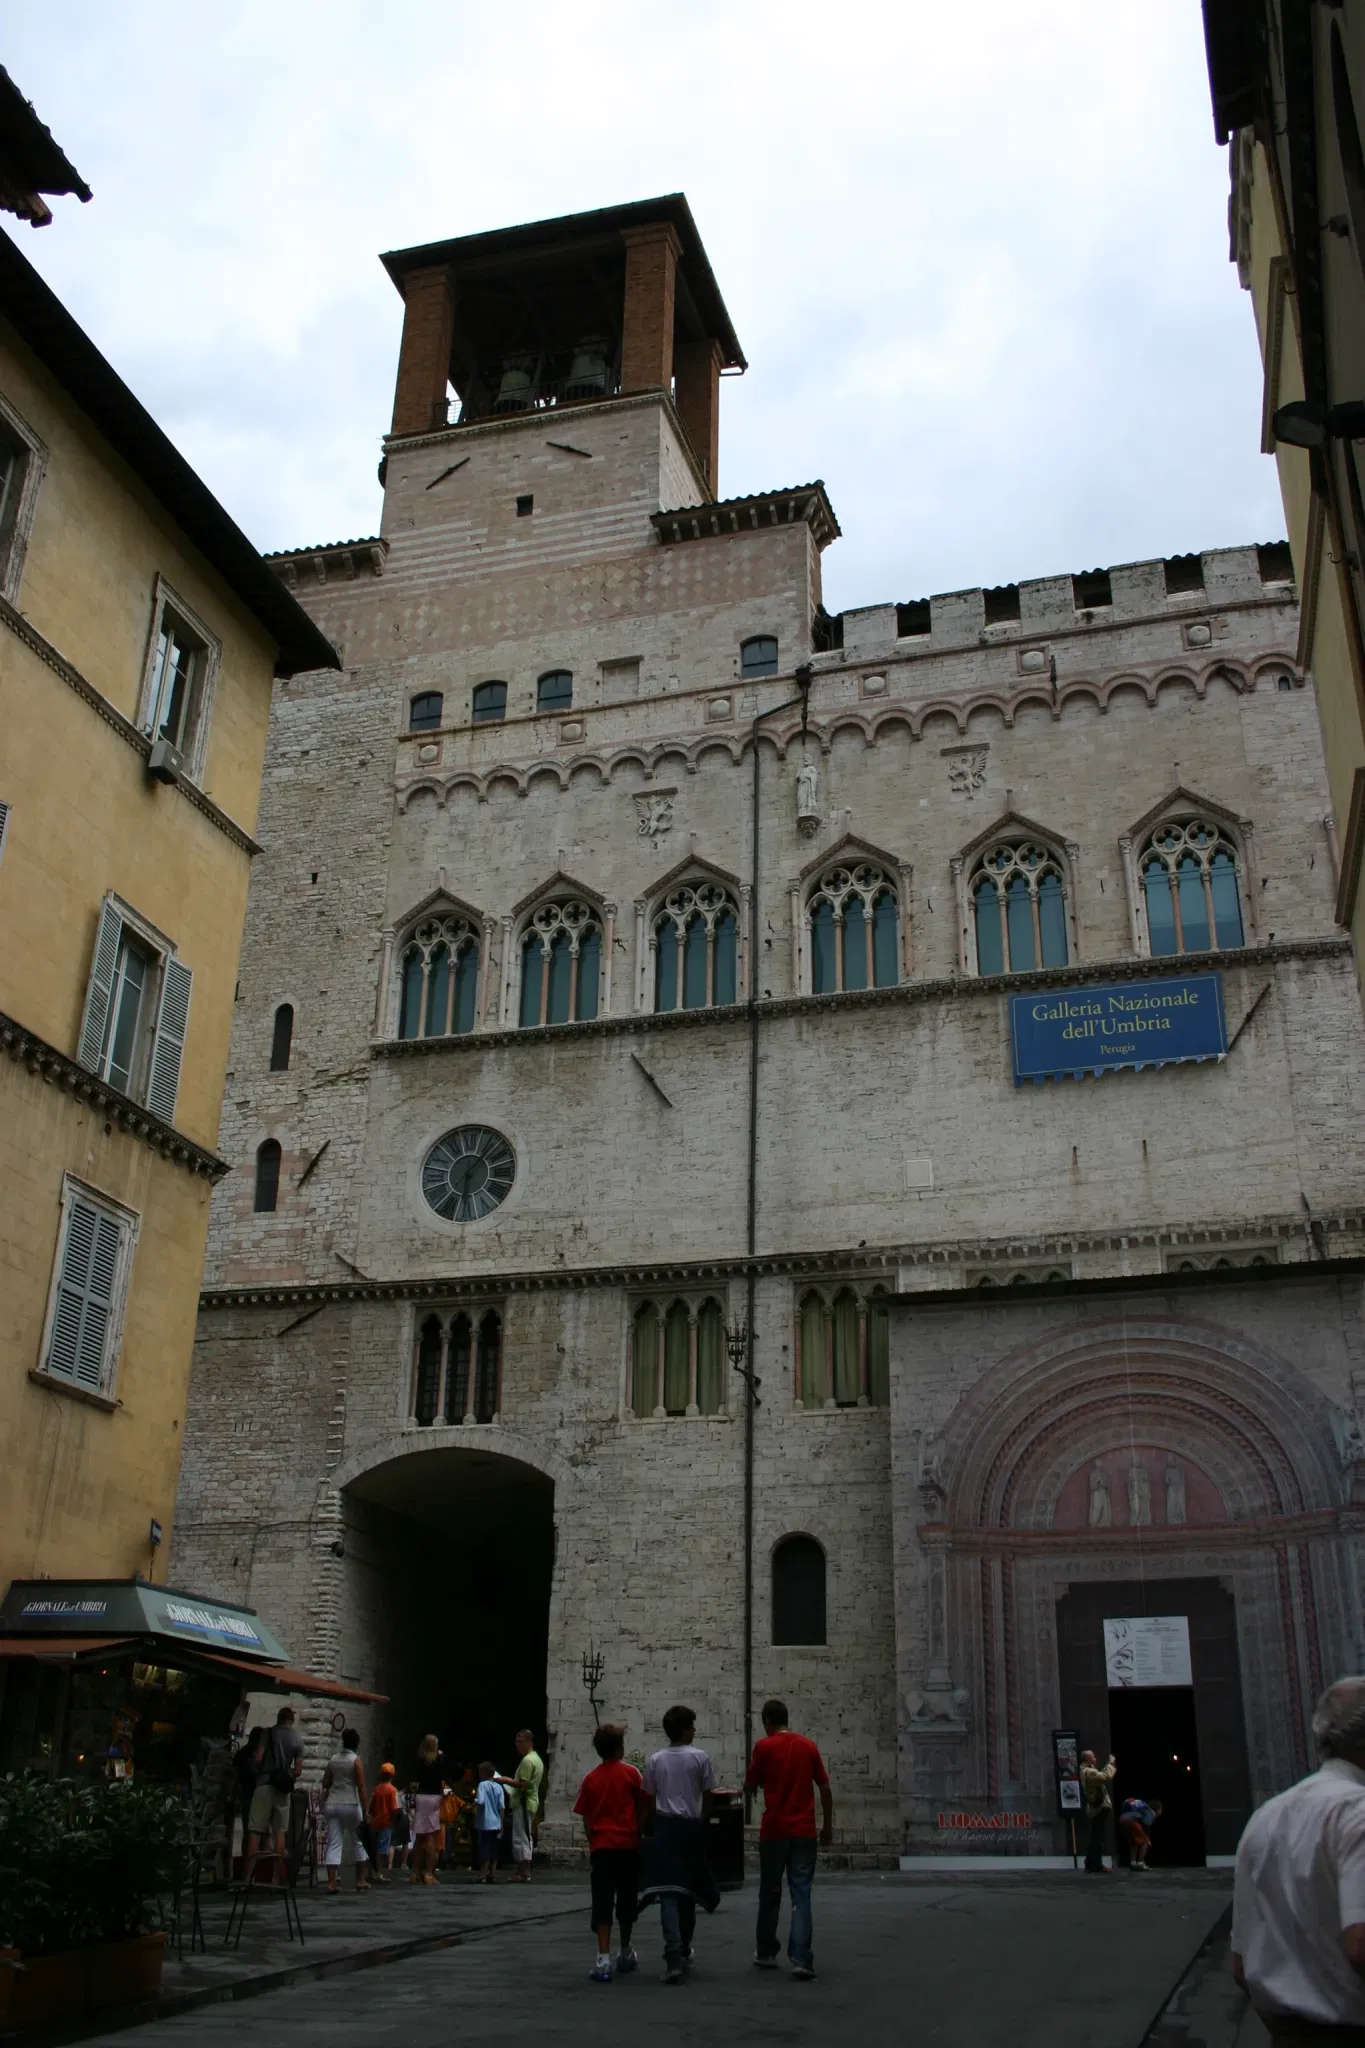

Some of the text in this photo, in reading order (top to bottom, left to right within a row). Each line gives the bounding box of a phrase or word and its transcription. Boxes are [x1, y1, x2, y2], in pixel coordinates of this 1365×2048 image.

[1032, 988, 1199, 1021] Galleria Nazionale
[1062, 1014, 1171, 1039] dell'Umbria
[1100, 1042, 1136, 1055] Perugia
[938, 1811, 1032, 1829] LIOMATIC
